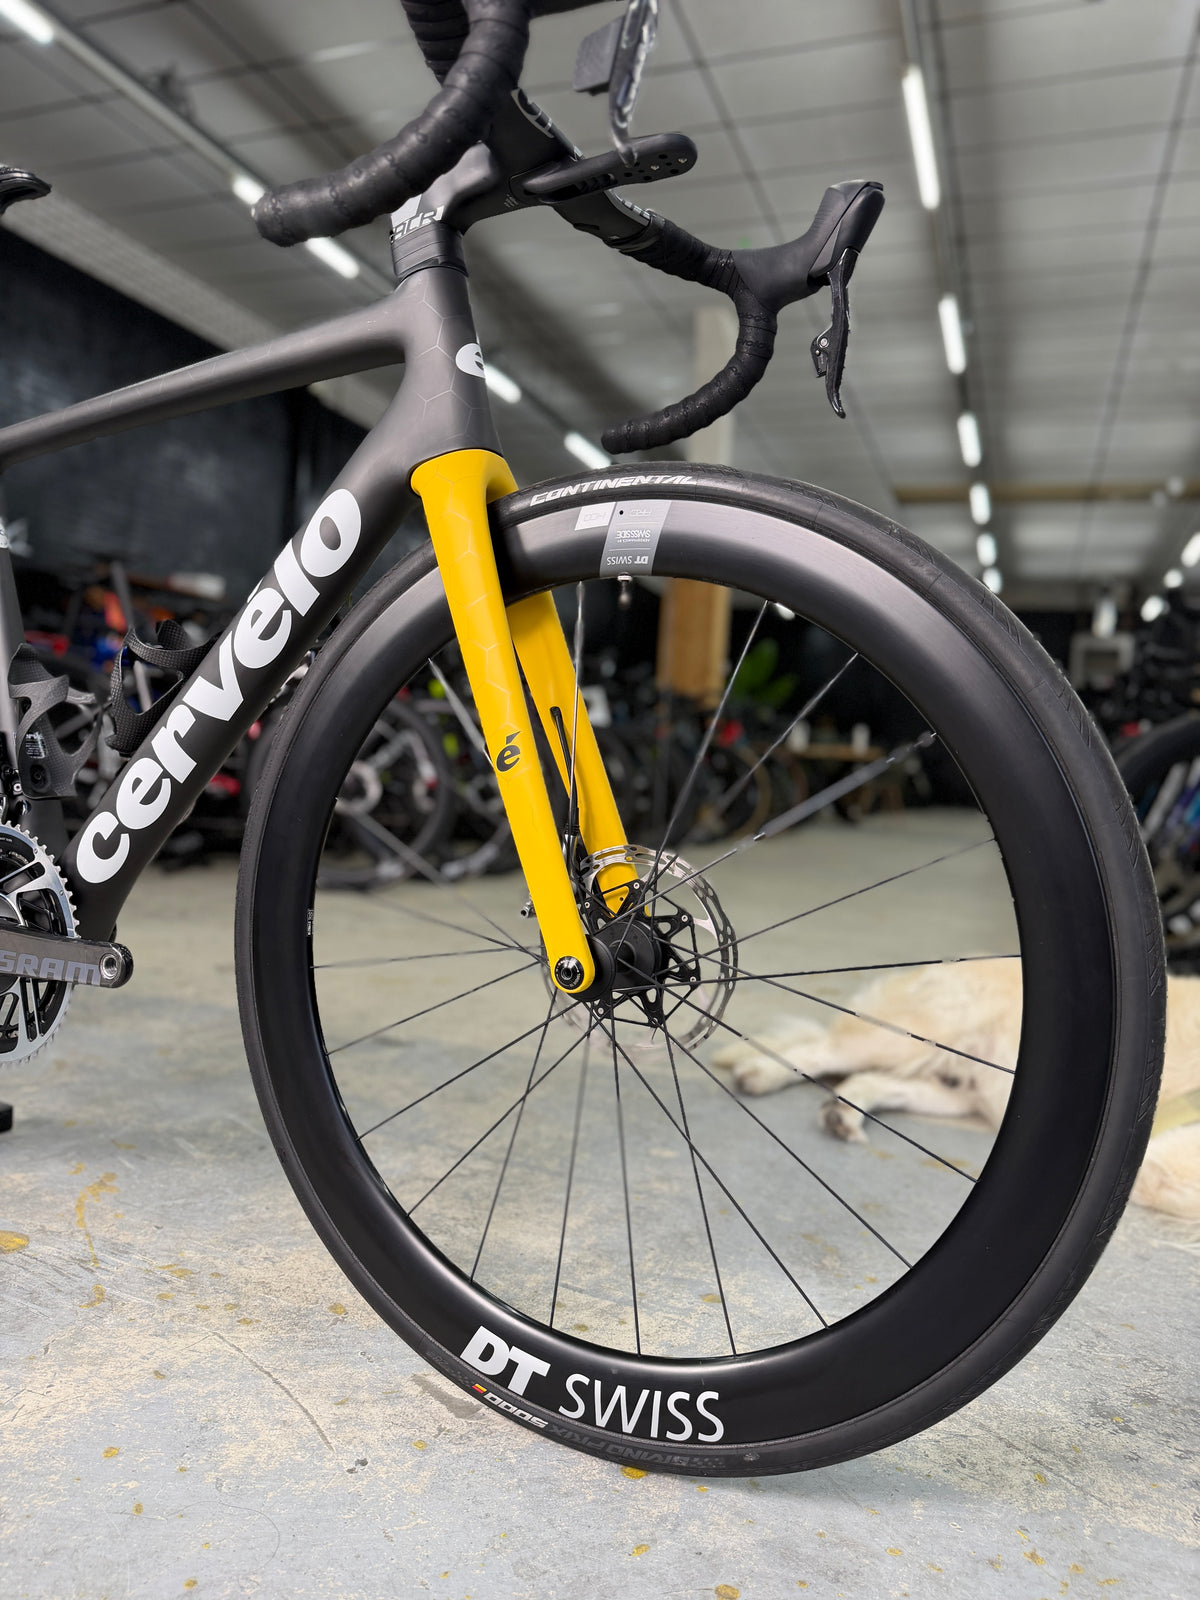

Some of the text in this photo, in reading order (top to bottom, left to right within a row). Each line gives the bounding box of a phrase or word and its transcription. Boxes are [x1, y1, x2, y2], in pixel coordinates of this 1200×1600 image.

[530, 474, 698, 506] CONTINENTAL
[606, 555, 649, 566] DT SWISS
[76, 488, 361, 884] cervélo
[496, 731, 522, 773] é
[0, 950, 101, 987] SRAM
[459, 1326, 725, 1443] DT SWISS
[483, 1391, 549, 1429] 5000
